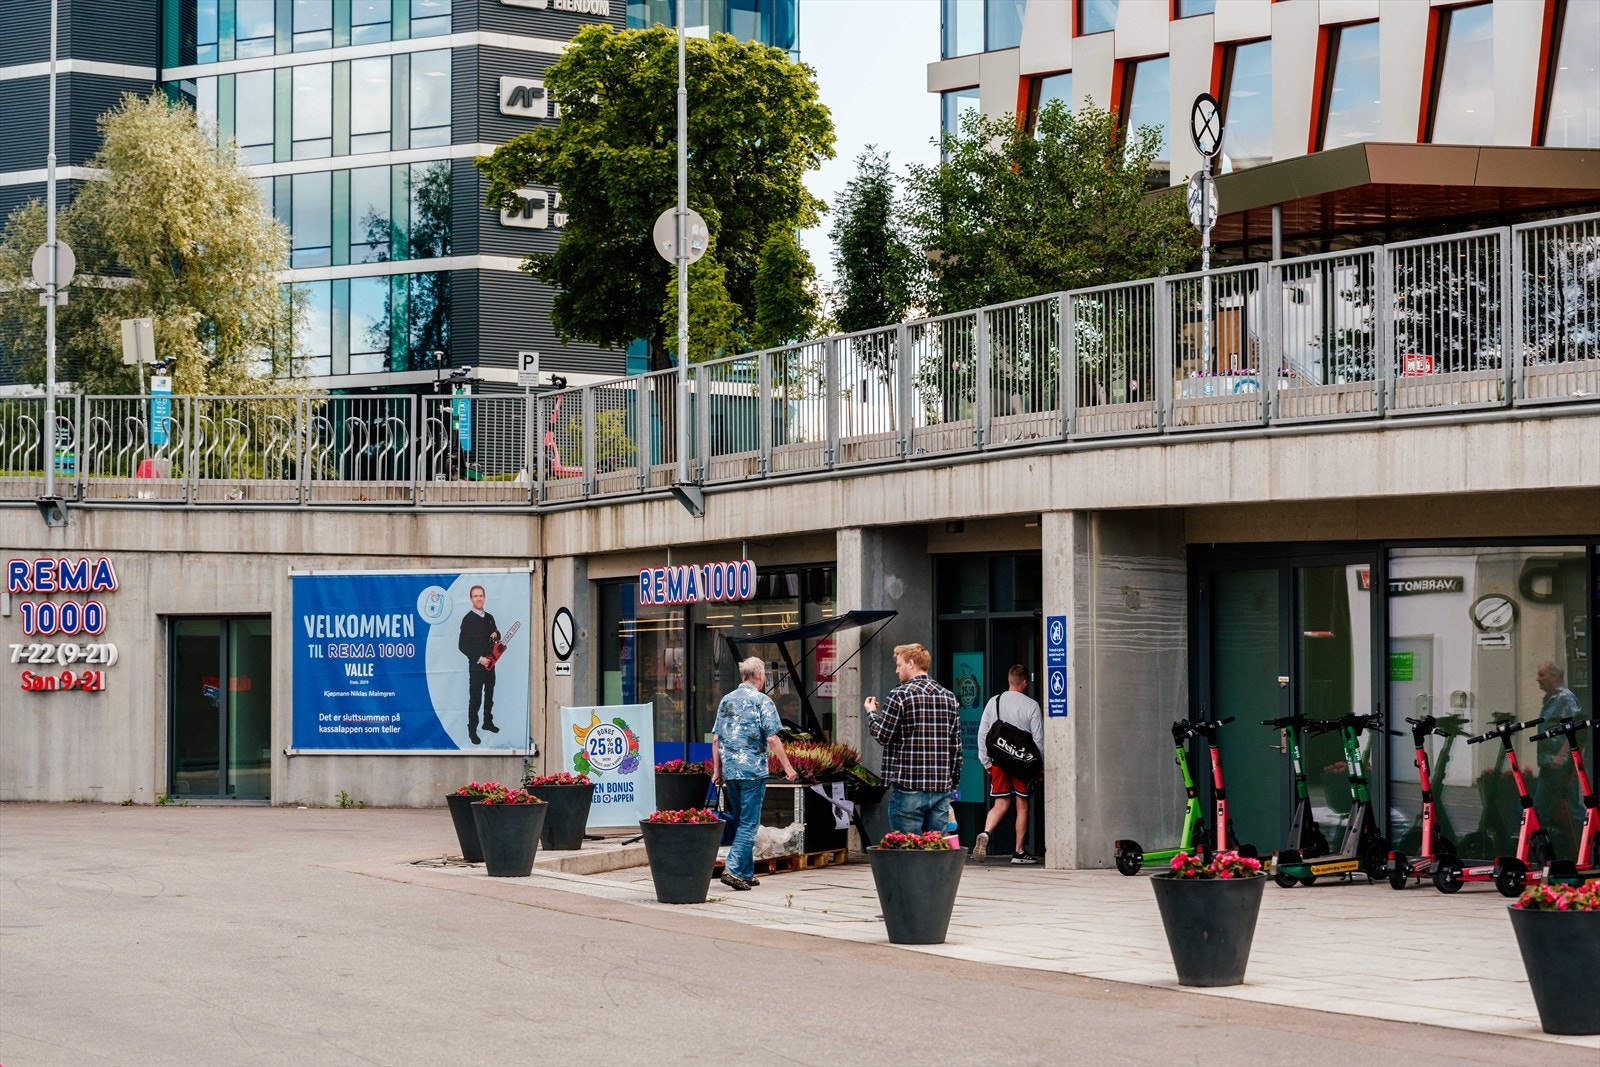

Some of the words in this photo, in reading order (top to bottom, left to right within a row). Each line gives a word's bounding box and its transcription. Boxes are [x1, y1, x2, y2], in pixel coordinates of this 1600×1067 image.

[506, 86, 545, 108] AF
[523, 354, 534, 371] P
[8, 557, 118, 594] REMA
[640, 564, 702, 606] REMA
[703, 560, 757, 601] 1000
[20, 600, 106, 636] 1000
[303, 613, 415, 638] VELKOMMEN
[9, 643, 56, 664] 7-22
[57, 642, 118, 666] (9-21)
[308, 644, 324, 658] TIL
[328, 643, 376, 658] REMA
[378, 643, 416, 658] 1000
[344, 663, 374, 677] VALLE
[20, 670, 59, 691] Søn
[61, 670, 106, 691] 9-21
[323, 690, 350, 698] Kjøpmann
[369, 690, 396, 698] Malmgren
[319, 713, 332, 722] Det
[333, 714, 341, 722] er
[342, 713, 390, 722] sluttsummen
[391, 713, 401, 722] på
[319, 725, 363, 734] kassalappen
[381, 725, 401, 733] teller
[597, 728, 615, 736] BONUS
[590, 737, 606, 755] 25
[614, 737, 623, 754] 8
[607, 782, 634, 793] BONUS
